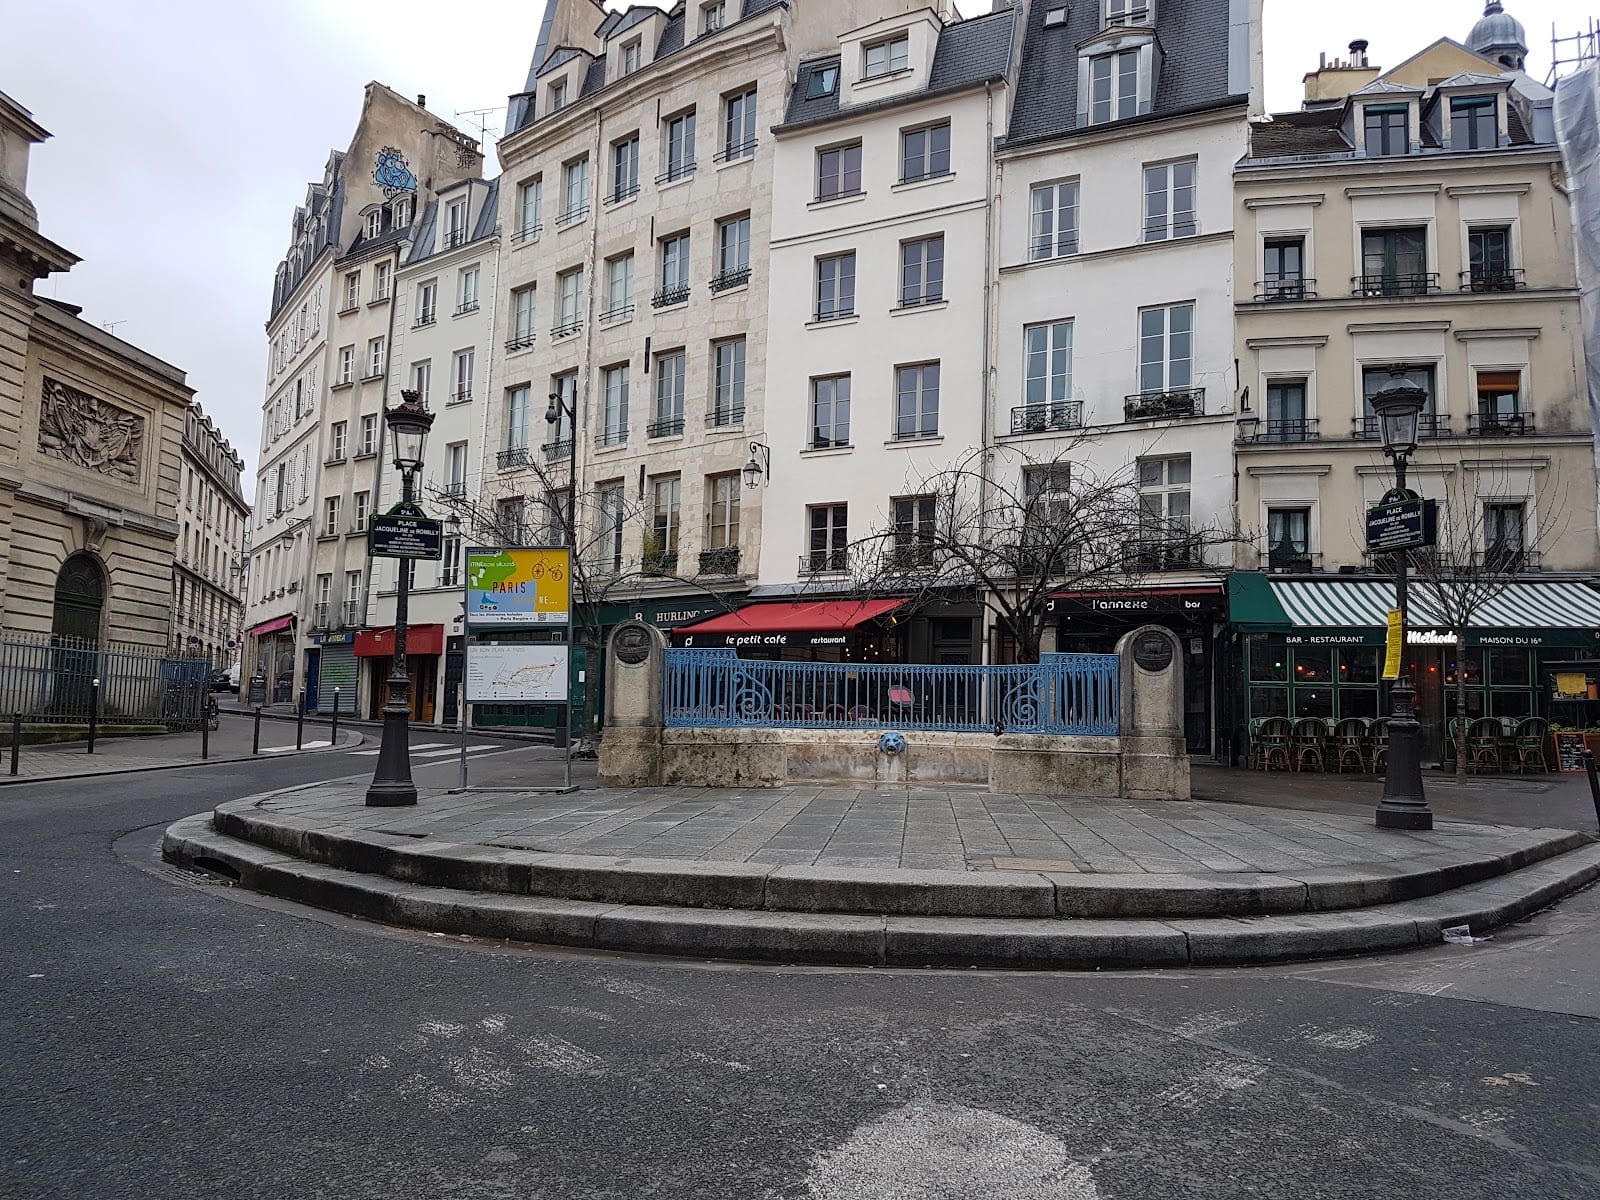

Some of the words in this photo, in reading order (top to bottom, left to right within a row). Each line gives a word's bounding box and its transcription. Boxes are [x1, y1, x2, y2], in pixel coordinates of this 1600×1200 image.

[1386, 507, 1402, 515] PLACE
[492, 581, 526, 594] PARIS
[1092, 599, 1148, 609] l'annexe
[1184, 600, 1201, 609] bar
[726, 635, 735, 644] le
[736, 635, 762, 645] petit
[763, 634, 787, 644] café
[810, 635, 846, 644] restaurant
